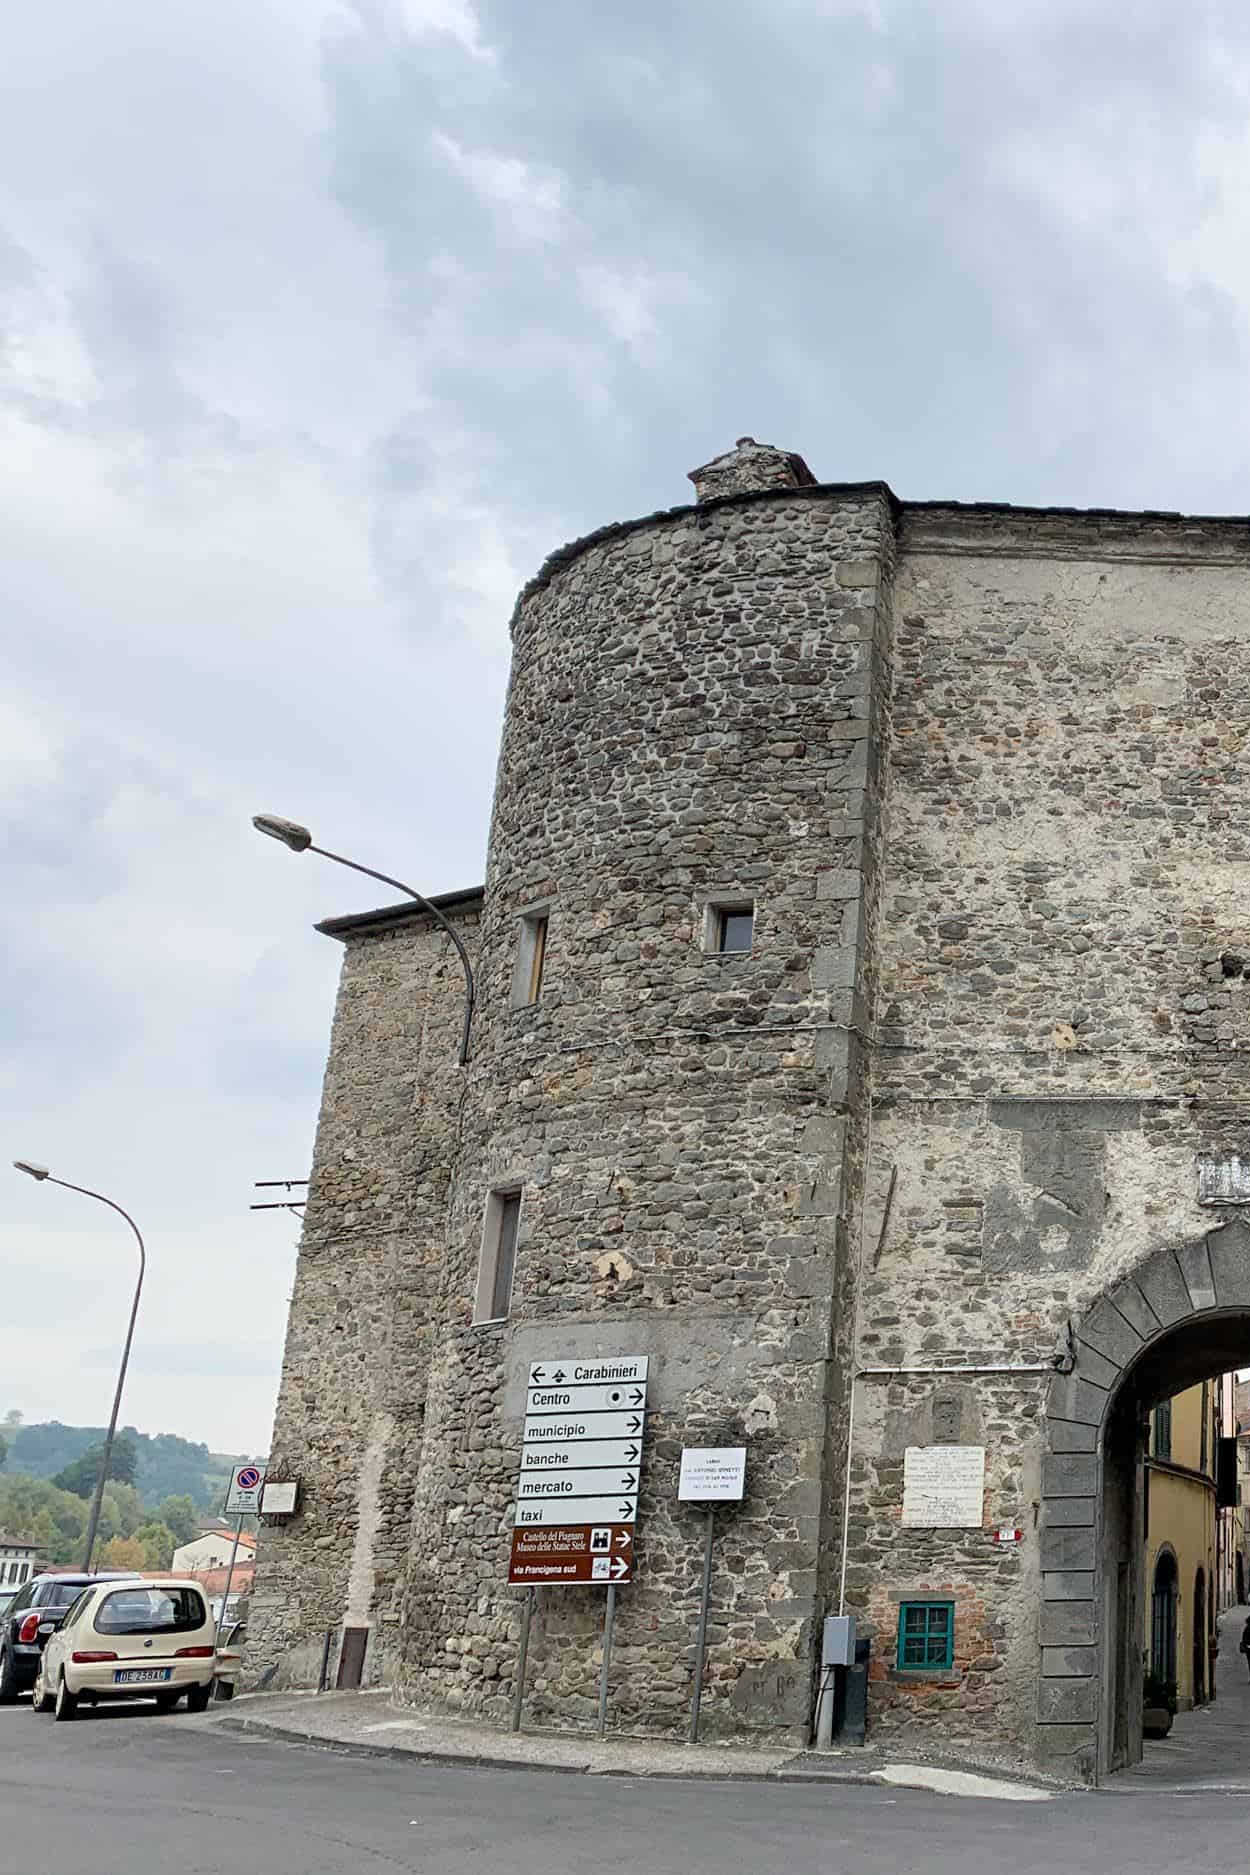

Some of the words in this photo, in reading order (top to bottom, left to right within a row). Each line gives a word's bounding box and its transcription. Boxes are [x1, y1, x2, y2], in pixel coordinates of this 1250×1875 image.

[574, 1363, 638, 1380] Carabinieri
[532, 1392, 570, 1405] Centro
[528, 1424, 586, 1437] municipio
[526, 1453, 569, 1465] banche
[522, 1481, 573, 1493] mercato
[521, 1509, 543, 1521] taxi
[523, 1531, 547, 1542] Castello
[547, 1531, 557, 1541] del
[537, 1541, 552, 1551] delle
